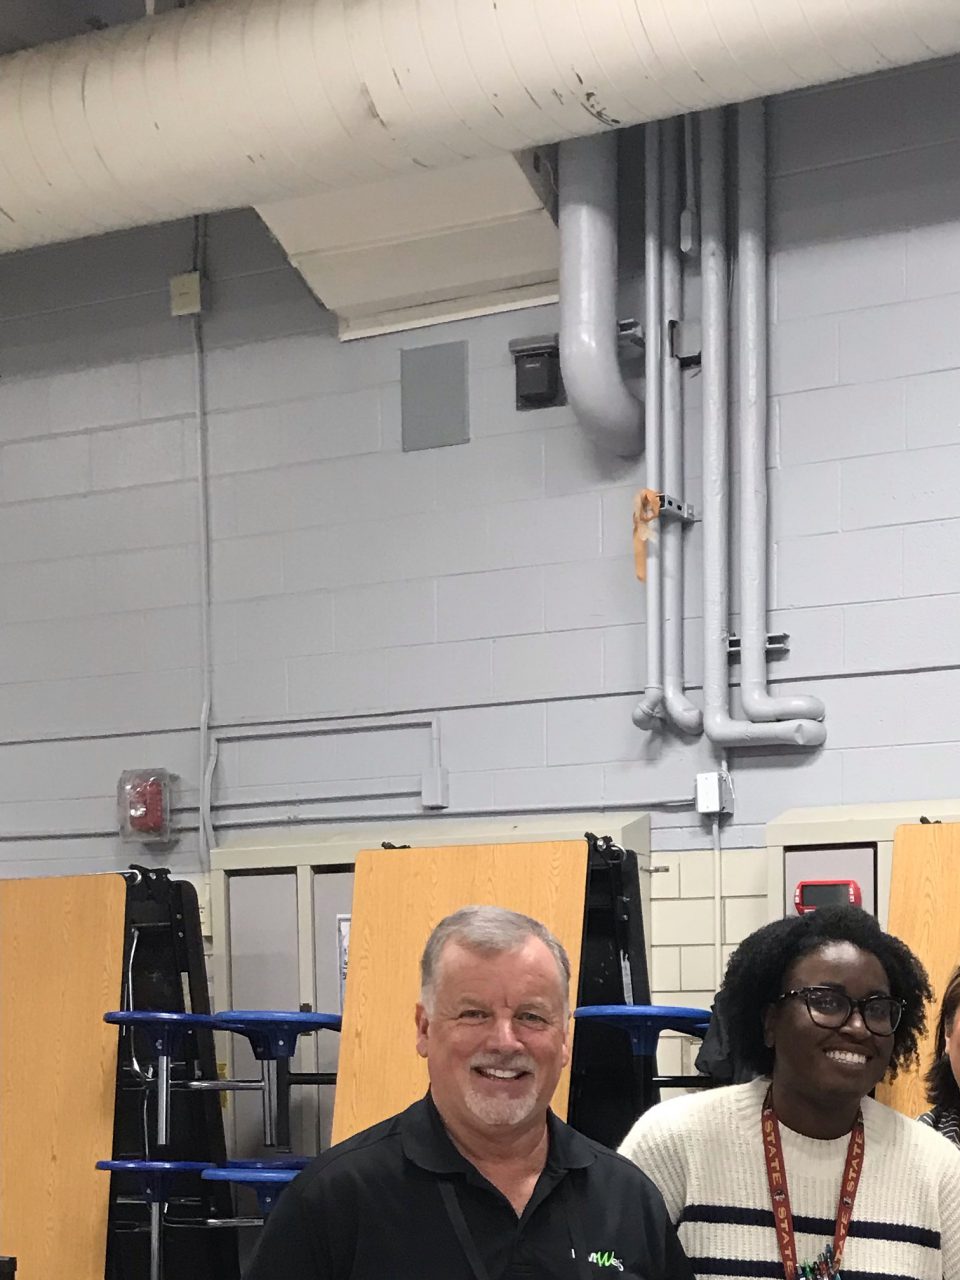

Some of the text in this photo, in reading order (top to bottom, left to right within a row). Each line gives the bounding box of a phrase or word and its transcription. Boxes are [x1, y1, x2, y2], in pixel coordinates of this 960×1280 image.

[764, 1120, 782, 1186] STATE
[846, 1131, 863, 1192] STATE
[778, 1206, 795, 1273] STATE
